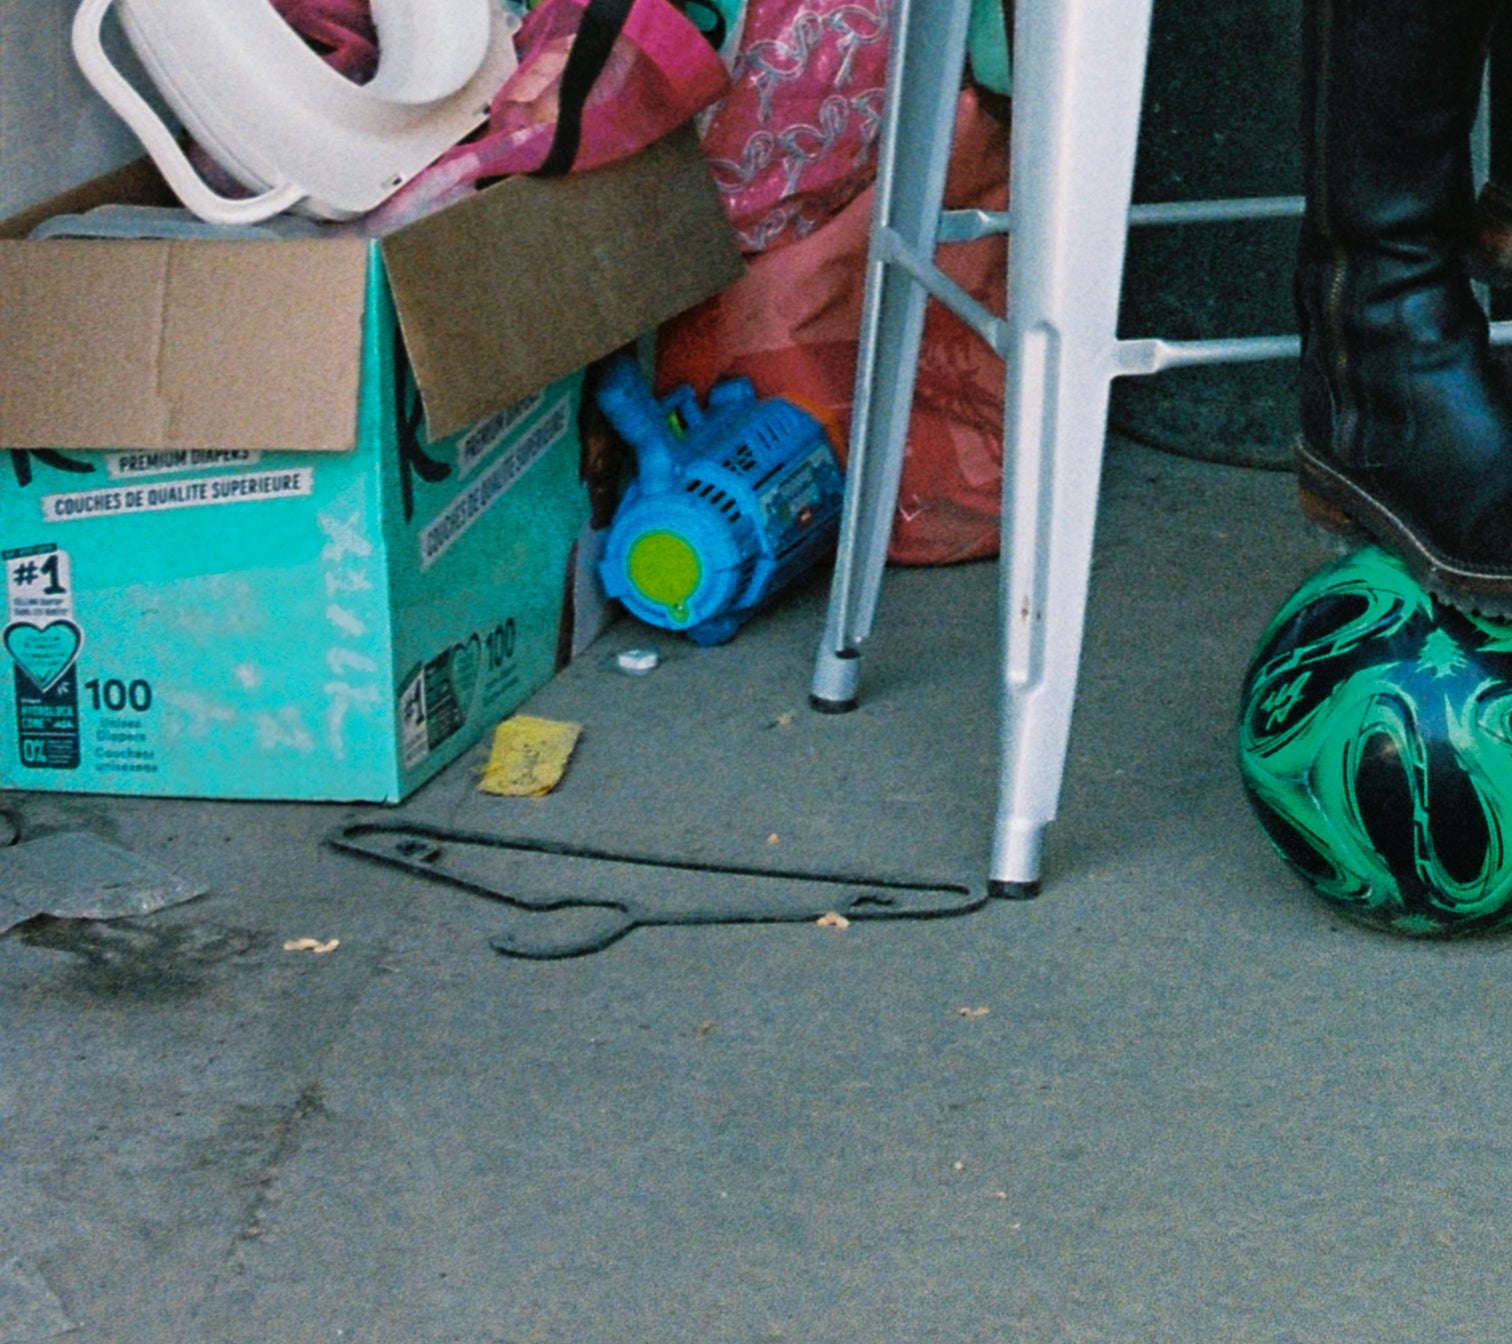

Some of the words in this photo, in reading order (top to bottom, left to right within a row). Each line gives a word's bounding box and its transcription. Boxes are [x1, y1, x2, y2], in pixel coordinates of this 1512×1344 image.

[119, 450, 187, 473] PREMIUM
[54, 490, 123, 516] COUCHES
[125, 487, 144, 508] DE
[147, 481, 208, 506] QUALITE
[210, 473, 302, 500] SUPERIEURE
[13, 555, 67, 595] #1
[84, 678, 153, 712] 100
